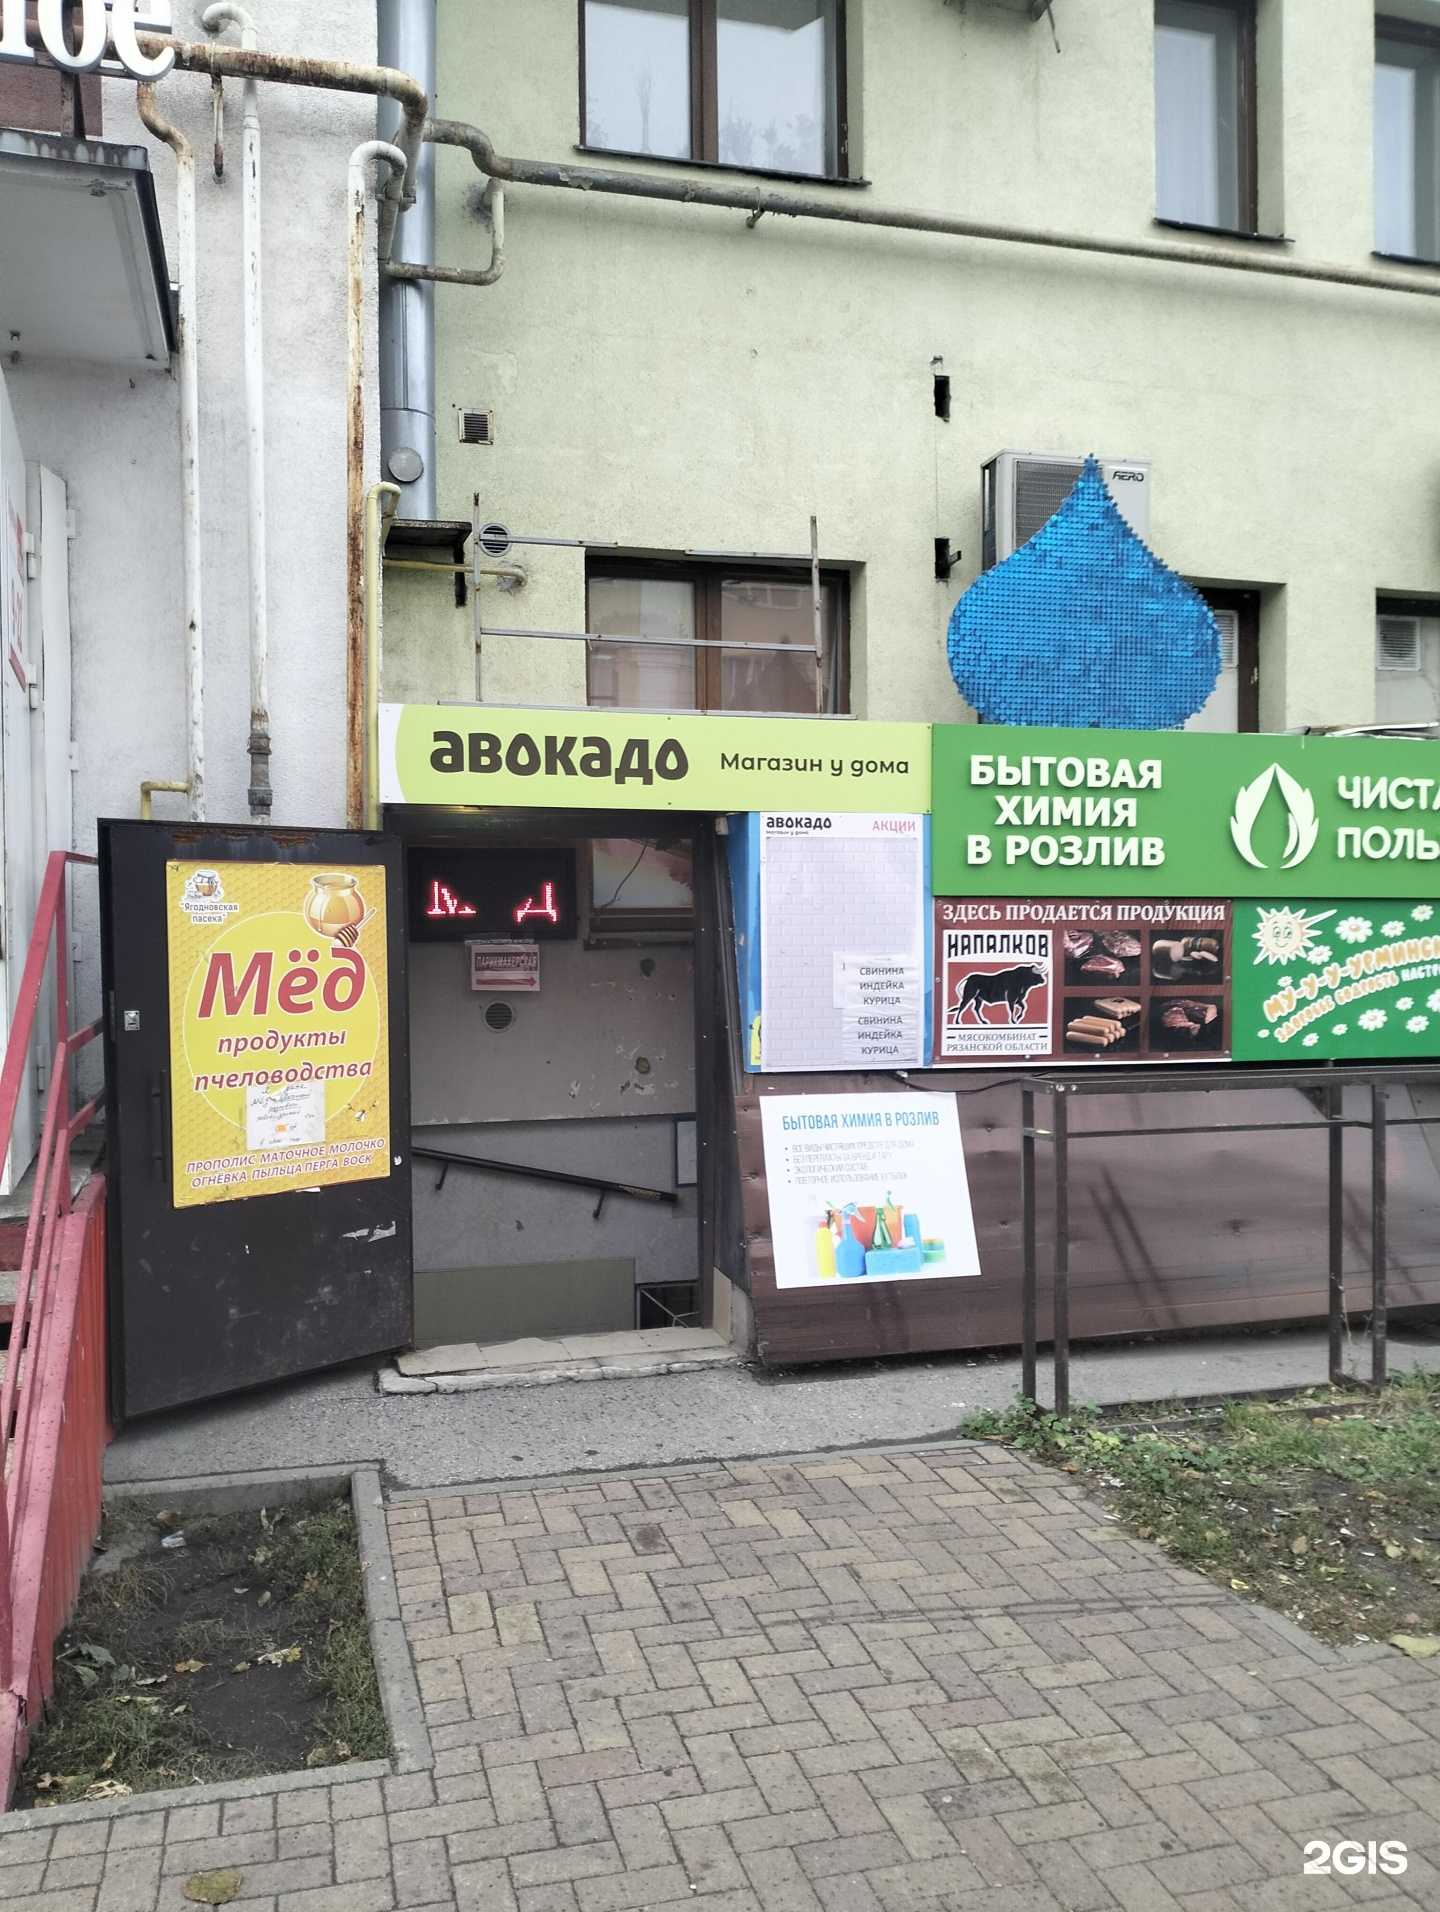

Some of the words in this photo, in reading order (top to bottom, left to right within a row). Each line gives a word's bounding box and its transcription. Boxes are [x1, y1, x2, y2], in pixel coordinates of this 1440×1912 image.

[1112, 470, 1145, 482] AERO
[430, 730, 689, 785] авокадо
[720, 752, 823, 772] Магазин
[830, 759, 844, 777] у
[850, 759, 910, 777] дома
[970, 755, 1163, 789] БЫТОВАЯ
[994, 795, 1138, 827] ХИМИЯ
[766, 817, 832, 829] авокадо
[872, 820, 916, 832] АКЦИИ
[967, 834, 993, 865] В
[1005, 835, 1166, 867] РОЗЛИВ
[943, 904, 1001, 923] ЗДЕСЬ
[1006, 904, 1112, 923] ПРОДАЕТСЯ
[1117, 905, 1225, 924] ПРОДУКЦИЯ
[947, 933, 1048, 959] НАПАЛКОВ
[859, 967, 905, 976] СВИНИНА
[1401, 963, 1440, 982] НАСТР
[197, 947, 366, 1018] Мёд
[859, 980, 905, 992] ИНДЕЙКА
[863, 996, 902, 1005] КУРИЦА
[857, 1016, 904, 1025] СВИНИНА
[218, 1030, 346, 1057] продукты
[857, 1030, 903, 1040] ИНДЕЙКА
[958, 1032, 1037, 1041] МЯСОКОМБИНАТ
[861, 1046, 900, 1055] КУРИЦА
[1004, 1042, 1048, 1052] ОБЛАСТИ
[194, 1061, 372, 1091] пчеловодства
[782, 1114, 838, 1131] БЫТОВАЯ
[841, 1112, 882, 1128] ХИМИЯ
[885, 1112, 892, 1127] В
[895, 1111, 939, 1127] РОЗЛИВ
[187, 1155, 256, 1173] ПРОПОЛИС
[260, 1146, 326, 1164] МАТОЧНОЕ
[329, 1138, 385, 1154] МОЛОЧКО
[252, 1165, 302, 1180] ПЫЛЬЦА
[304, 1160, 338, 1173] ПЕРГА
[343, 1153, 373, 1166] ВОСК
